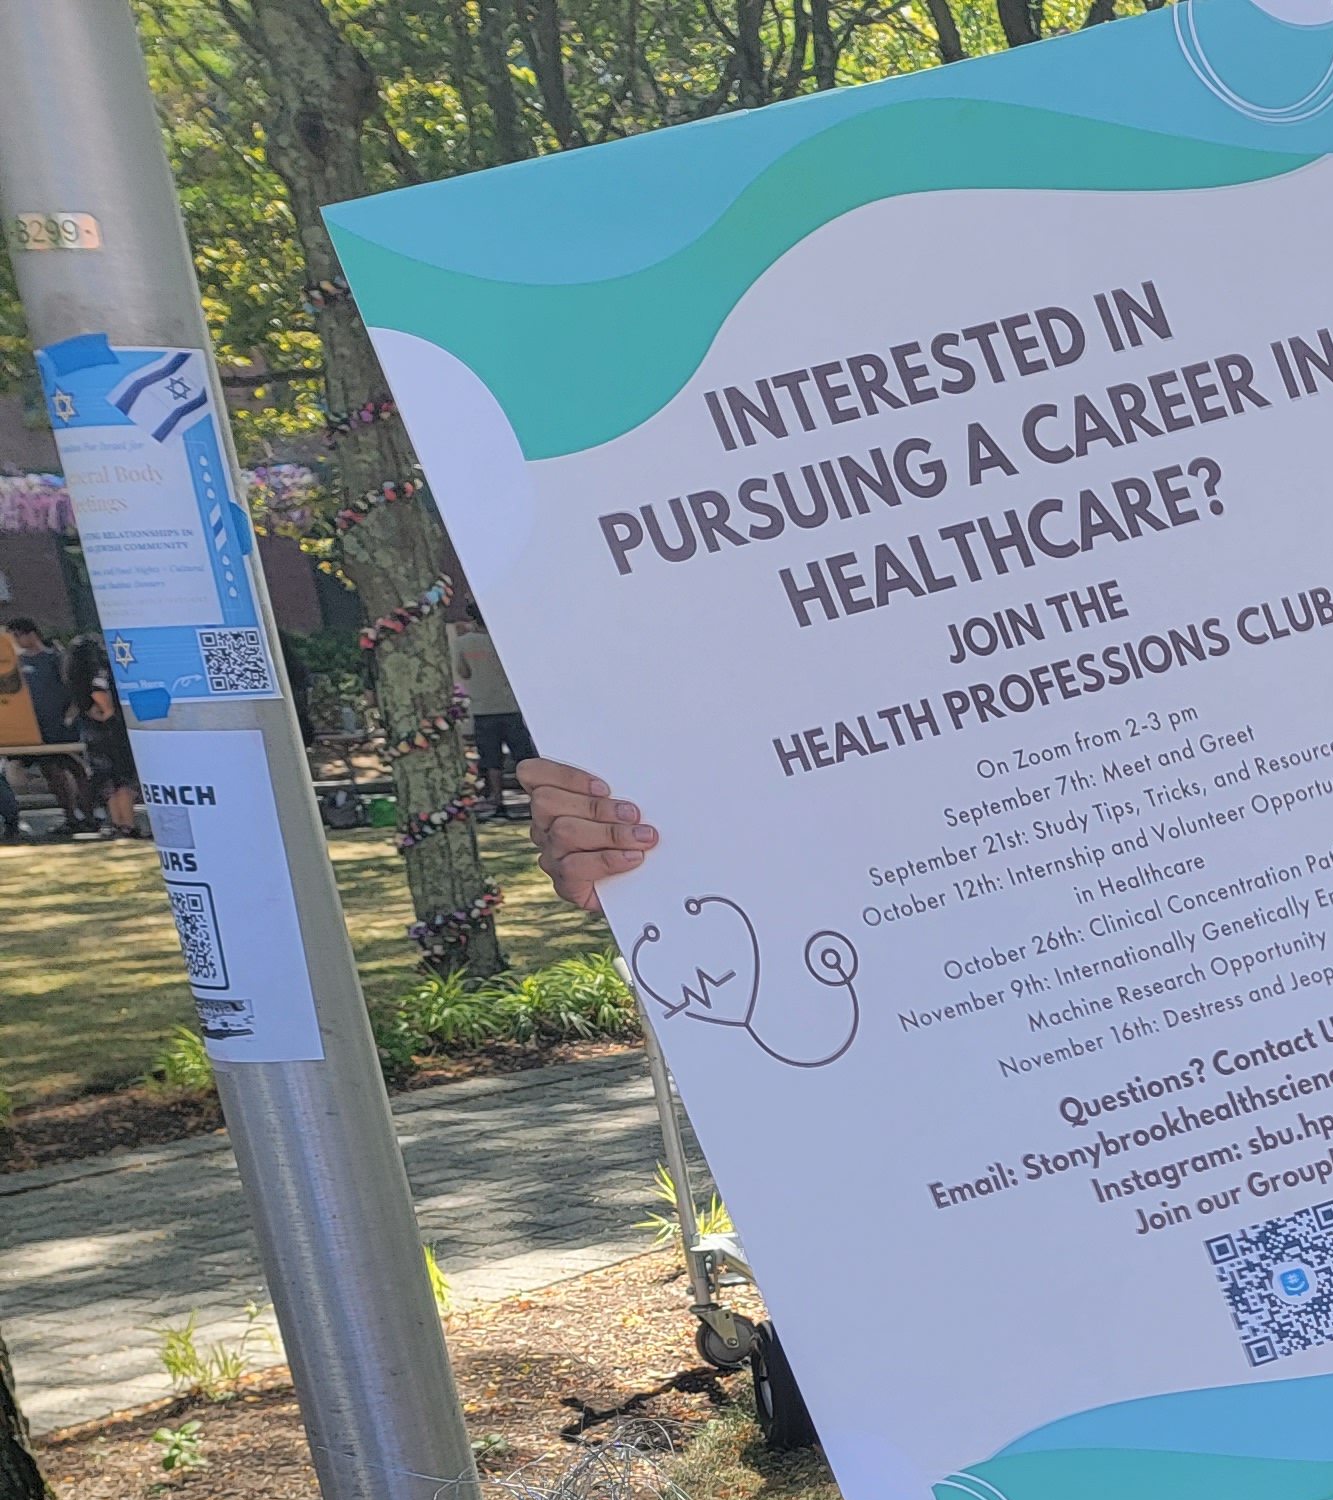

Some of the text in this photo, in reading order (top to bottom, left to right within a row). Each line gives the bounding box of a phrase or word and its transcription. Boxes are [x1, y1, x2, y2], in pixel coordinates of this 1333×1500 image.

[704, 280, 1173, 451] INTERESTED IN
[598, 438, 947, 575] PURSUING
[968, 422, 1019, 486] A
[1022, 354, 1272, 464] CAREER
[123, 541, 189, 551] COMMUNITY
[778, 457, 1224, 627] HEALTHCARE?
[948, 580, 1129, 664] JOIN THE
[772, 699, 941, 776] HEALTH
[942, 618, 1230, 730] PROFESSIONS
[977, 708, 1198, 778] On Zoom from 2-3 pm
[869, 846, 977, 886] September
[983, 830, 1028, 855] 21st:
[1033, 810, 1087, 839] Study
[1092, 802, 1139, 824] Tips,
[1143, 778, 1206, 807] Tricks,
[1214, 760, 1250, 787] and
[944, 725, 1254, 827] September 7th: Meet and Greet
[863, 893, 945, 926] October
[953, 873, 1003, 900] 12th:
[1007, 846, 1104, 885] Internship
[1112, 828, 1148, 855] and
[1150, 806, 1244, 842] Volunteer
[1074, 857, 1205, 904] in Healthcare
[898, 991, 1004, 1032] November
[1011, 974, 1051, 998] 9th:
[1054, 930, 1195, 985] Internationally
[1202, 895, 1309, 940] Genetically
[944, 946, 1026, 979] October
[1032, 926, 1084, 955] 26th:
[1090, 899, 1163, 936] Clinical
[1168, 866, 1302, 913] Concentration
[998, 1037, 1103, 1077] November
[1110, 1017, 1159, 1043] 16th:
[1163, 995, 1243, 1028] Destress
[1249, 974, 1285, 1002] and
[1028, 932, 1325, 1032] Machine Research Opportunity
[1060, 1058, 1205, 1128] Questions?
[1213, 1028, 1318, 1075] Contact
[927, 1163, 1018, 1209] Email:
[1091, 1143, 1242, 1203] Instagram:
[1136, 1201, 1192, 1234] Join
[1197, 1187, 1241, 1214] our
